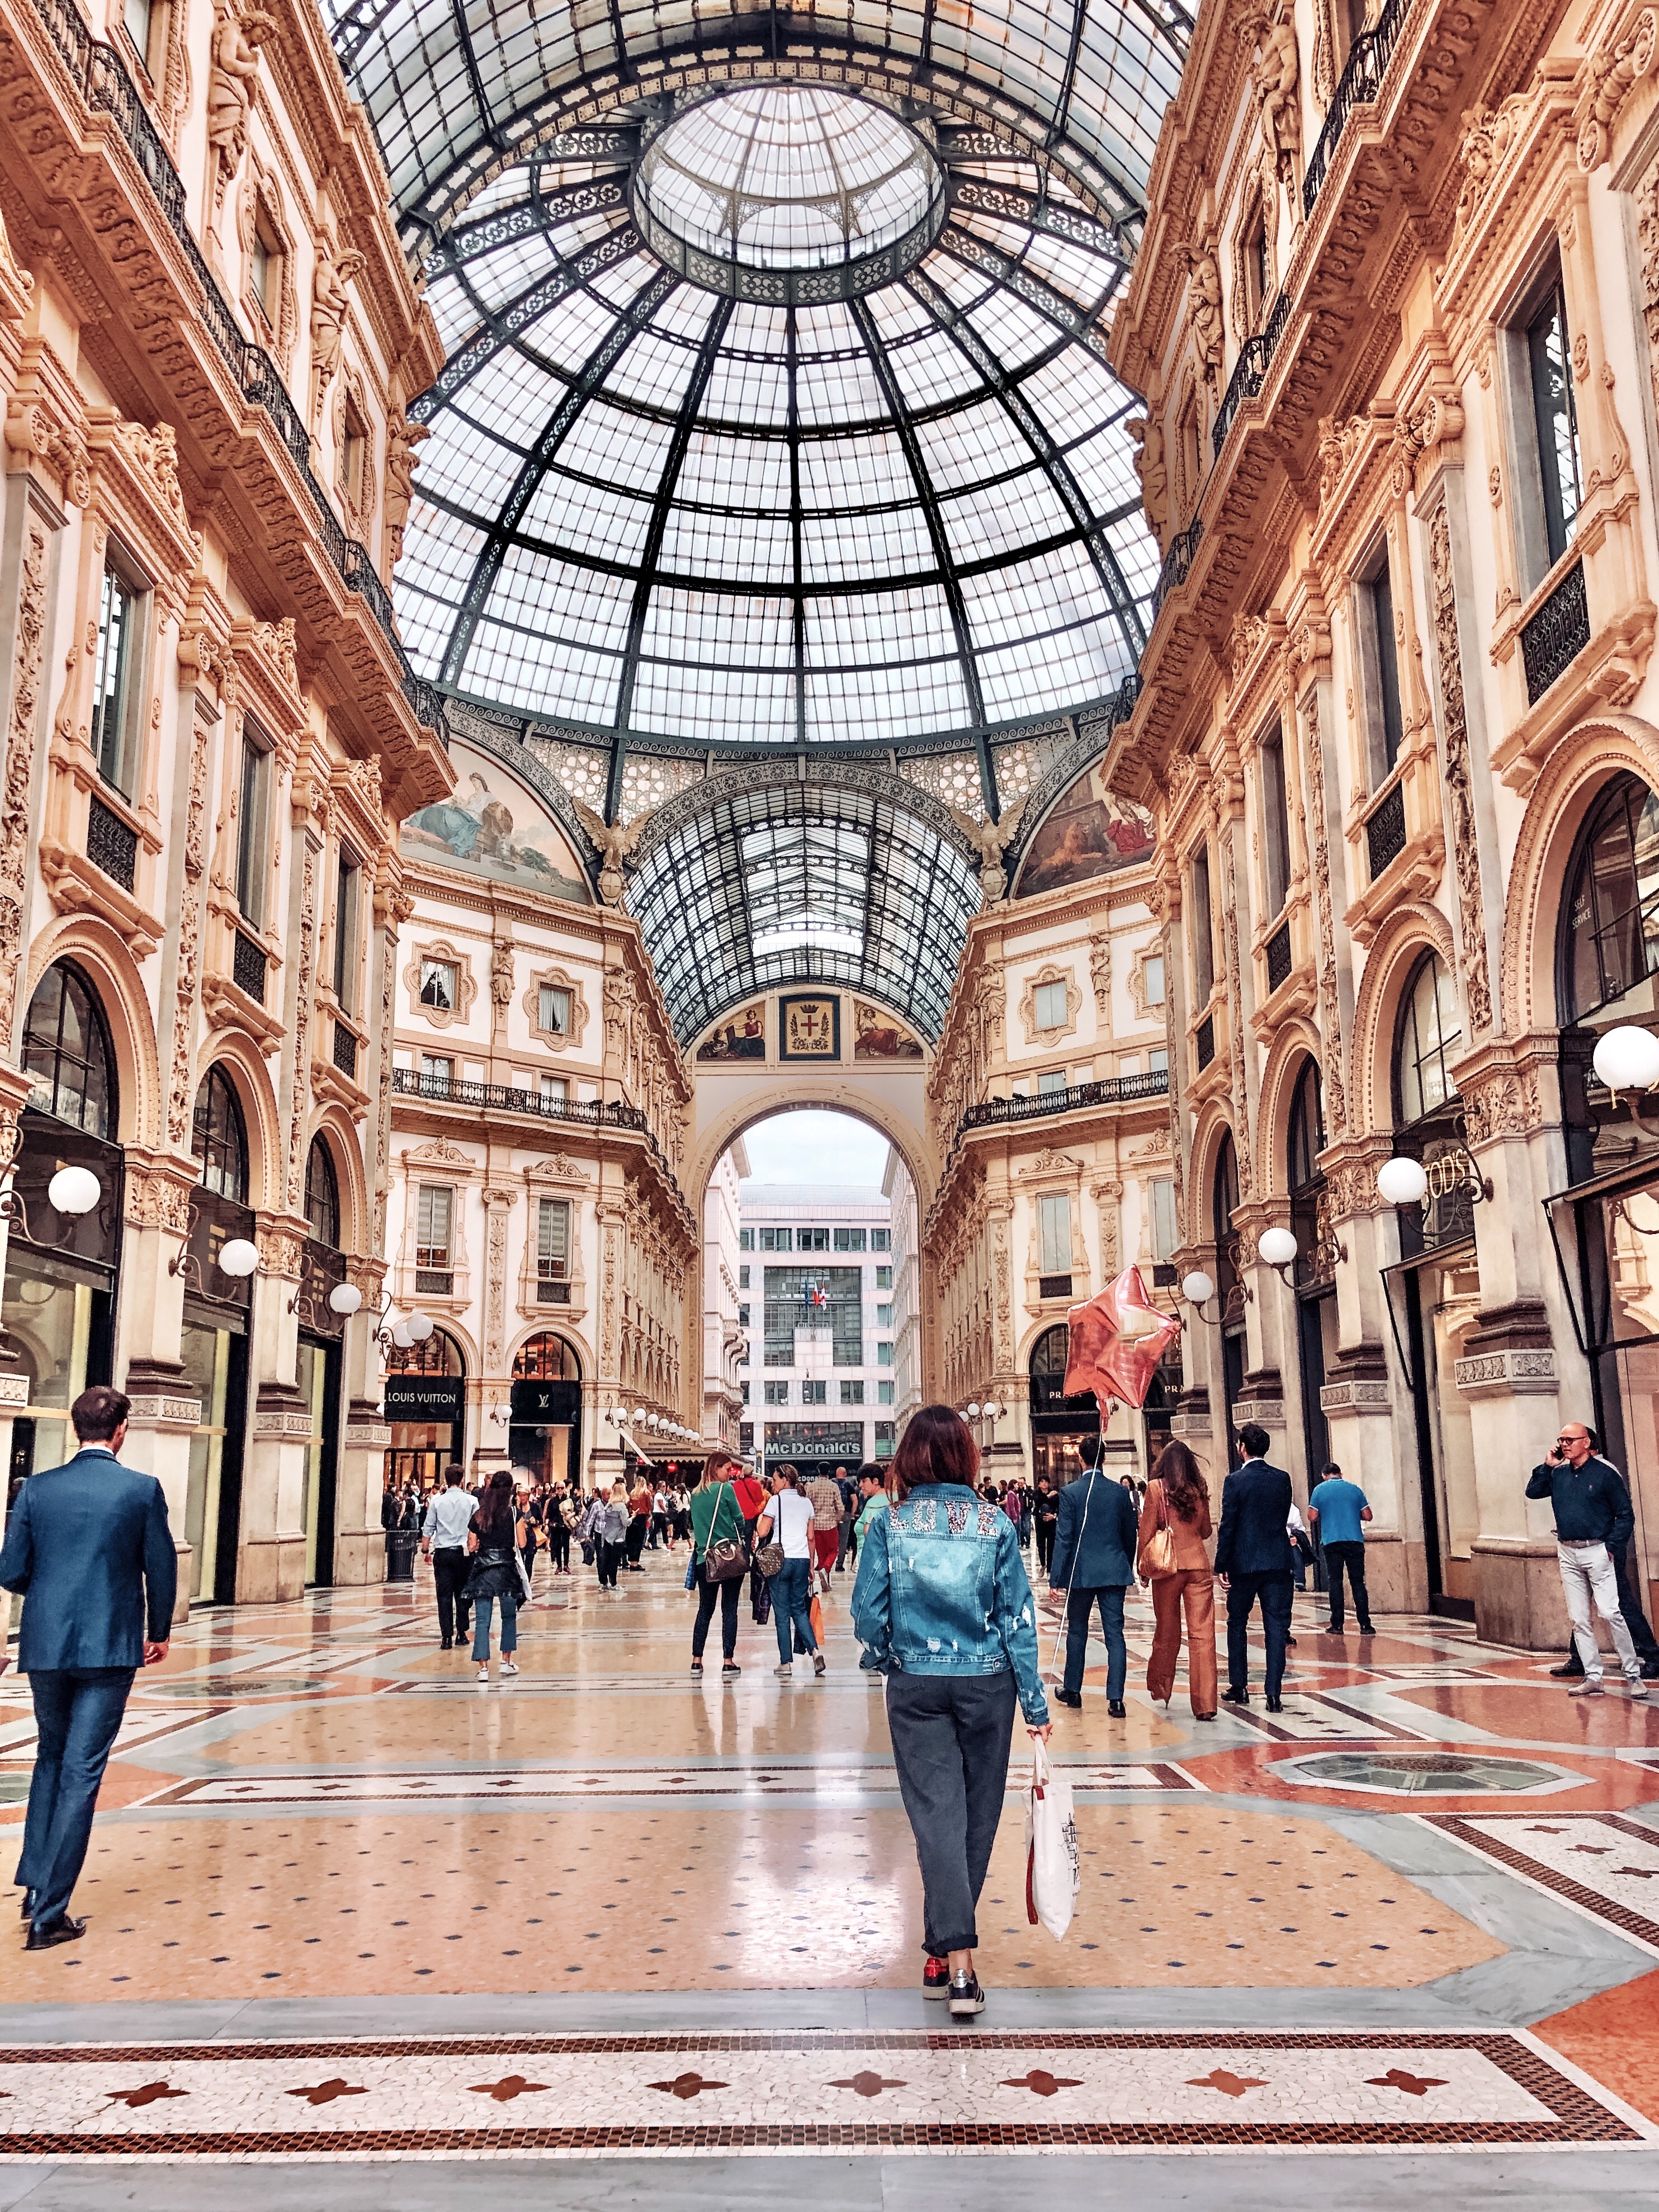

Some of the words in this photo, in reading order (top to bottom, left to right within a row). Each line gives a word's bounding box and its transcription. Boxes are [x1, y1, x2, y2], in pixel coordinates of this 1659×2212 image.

[1574, 894, 1585, 911] SELF
[1572, 907, 1591, 930] SERVICE
[388, 1392, 415, 1402] LOUIS
[417, 1393, 456, 1403] VUITTON
[764, 1442, 861, 1454] McDonald's
[888, 1499, 999, 1537] LOVE
